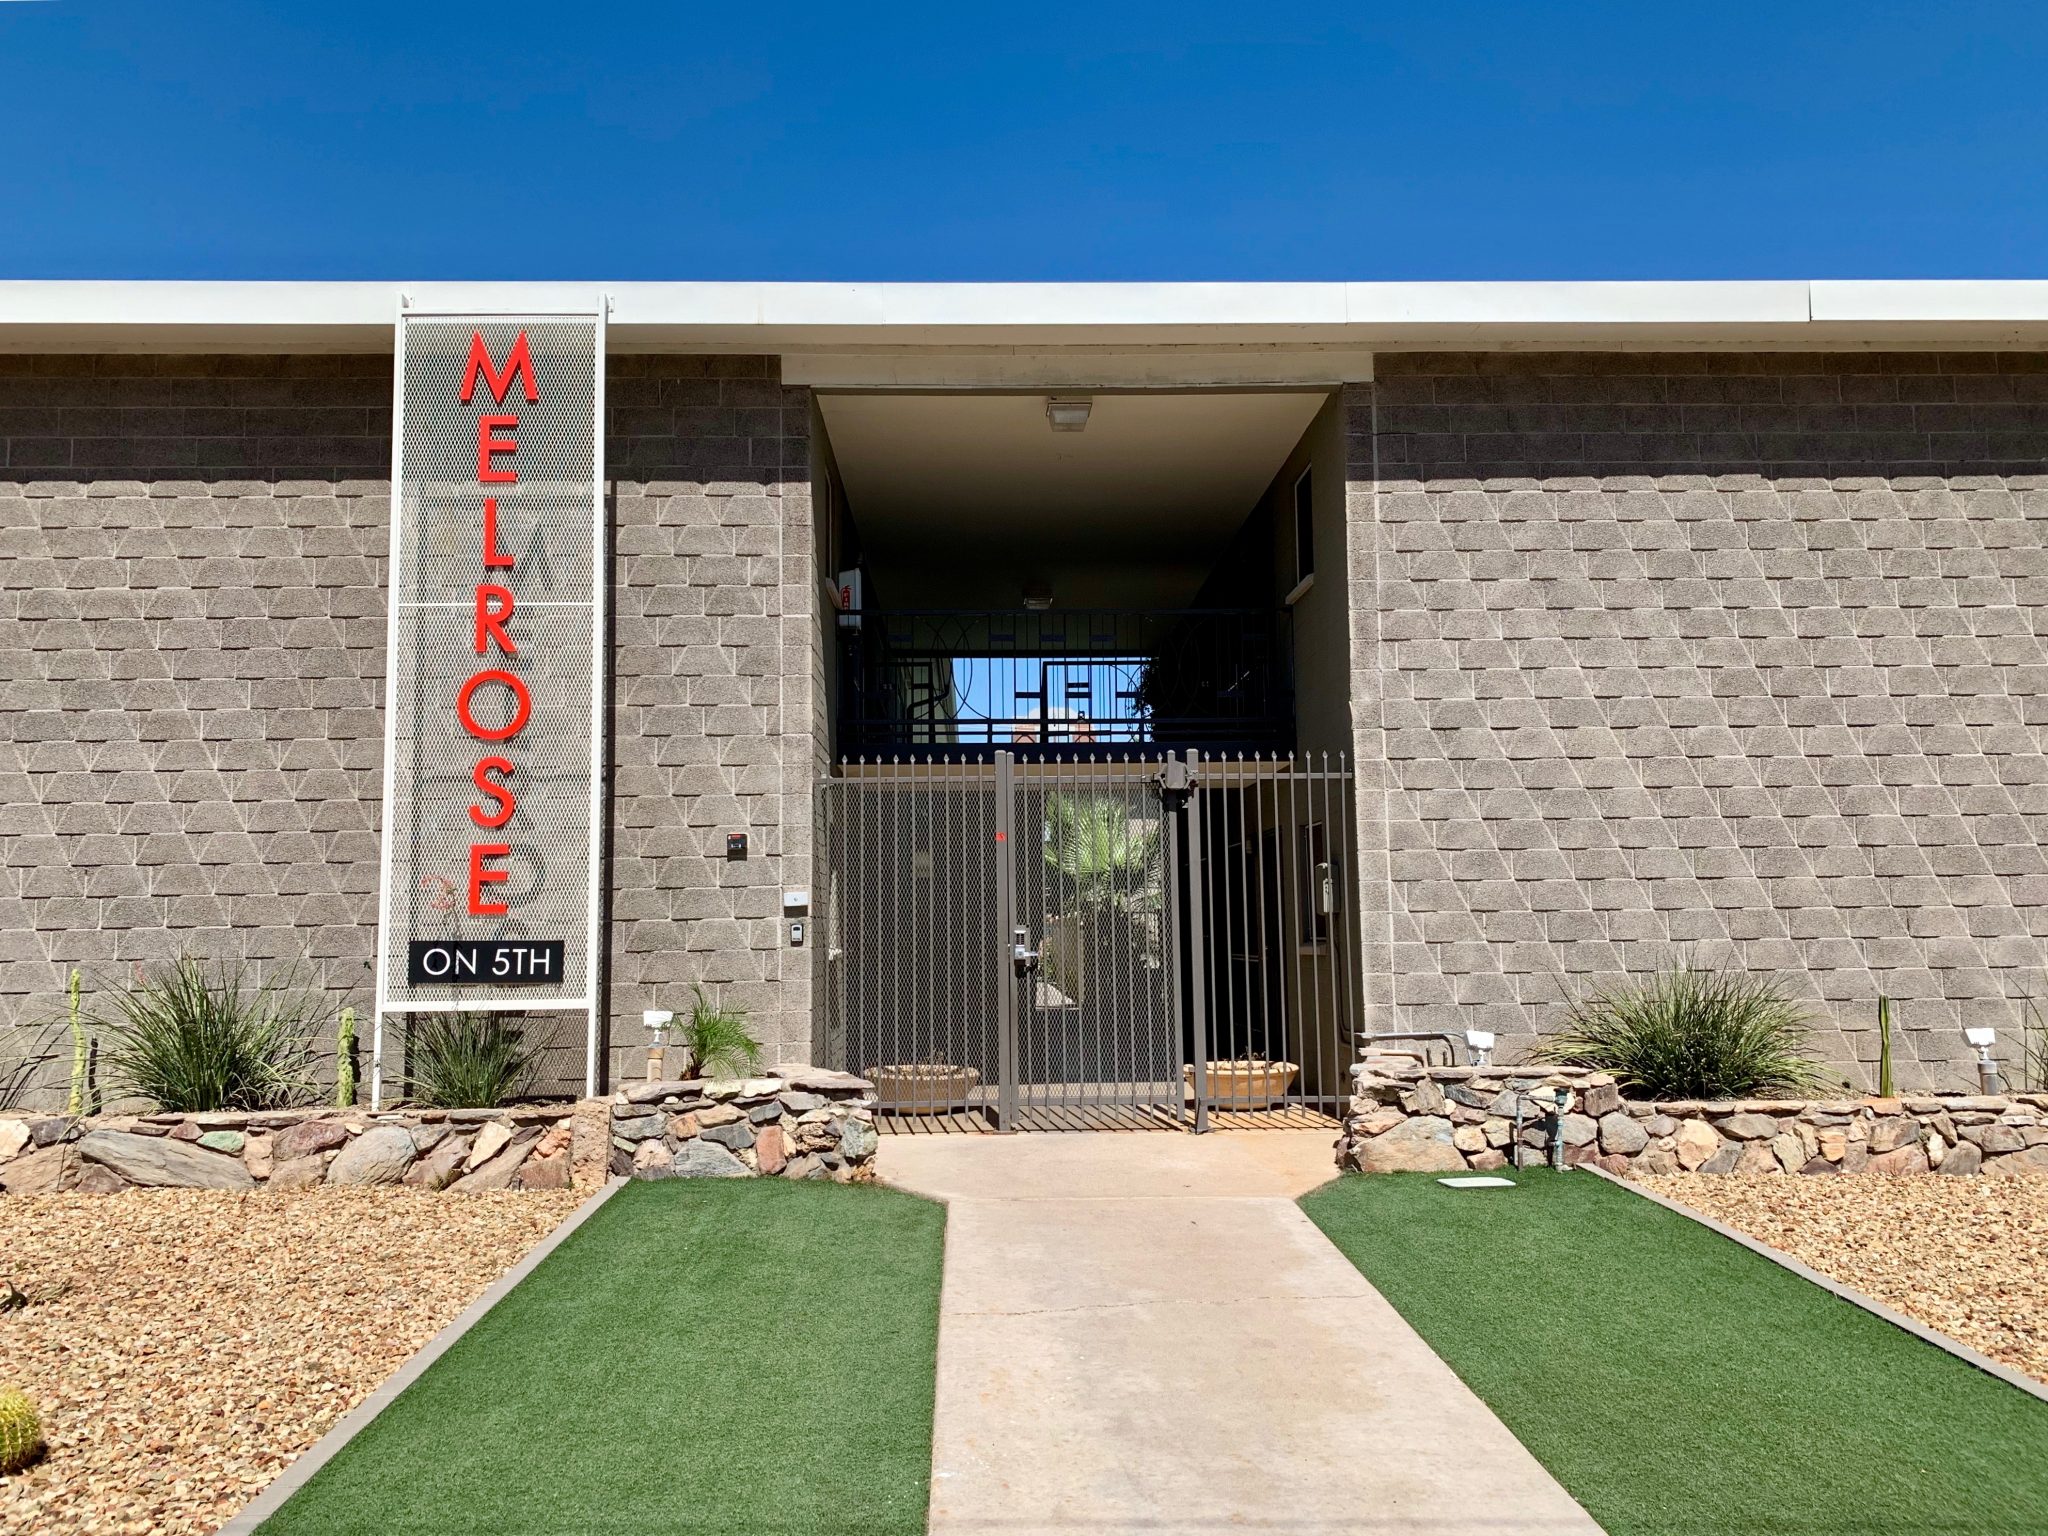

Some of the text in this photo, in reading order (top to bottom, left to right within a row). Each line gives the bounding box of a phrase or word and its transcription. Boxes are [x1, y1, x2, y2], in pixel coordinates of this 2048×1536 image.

[457, 330, 539, 916] MELROSE
[422, 948, 550, 976] ON 5TH
